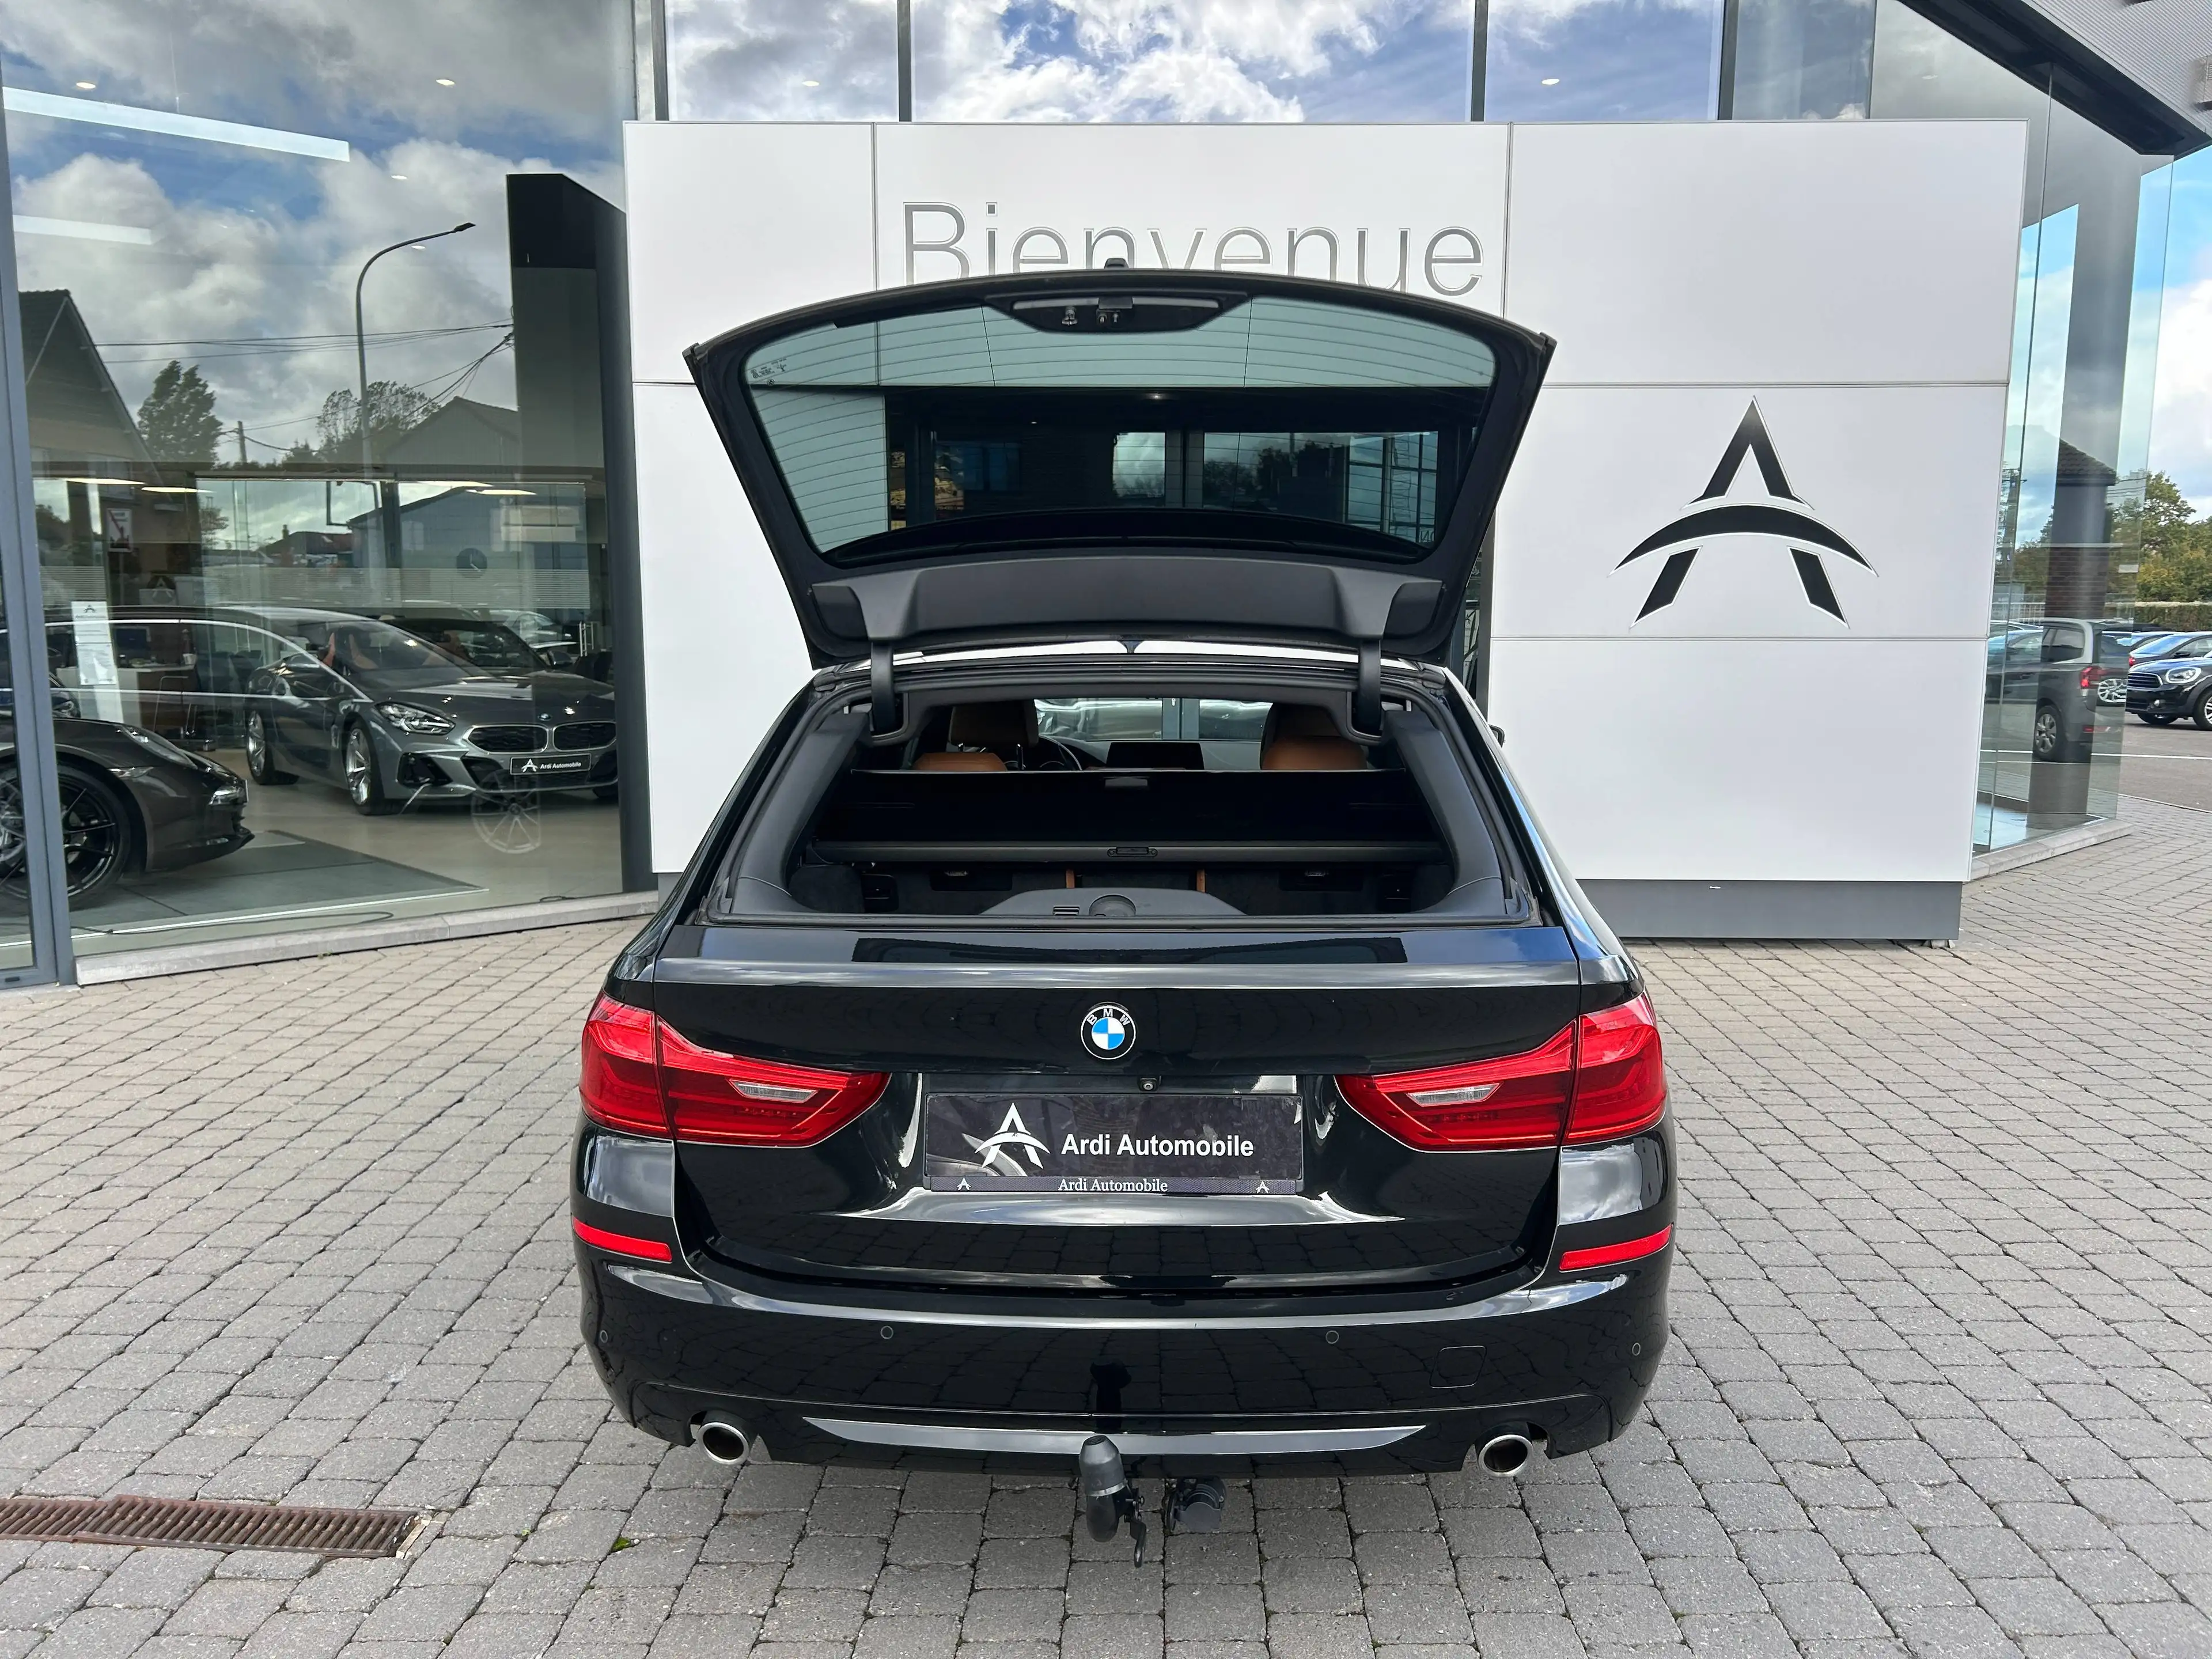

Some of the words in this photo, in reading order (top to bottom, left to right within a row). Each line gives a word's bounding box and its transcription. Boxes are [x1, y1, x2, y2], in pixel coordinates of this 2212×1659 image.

[903, 202, 1483, 296] Bienvenue
[1086, 1008, 1131, 1026] BMW
[1061, 1134, 1111, 1155] Ardi
[1116, 1134, 1254, 1157] Automobile
[1058, 1178, 1088, 1191] Ardi
[1090, 1178, 1169, 1192] Automobile
